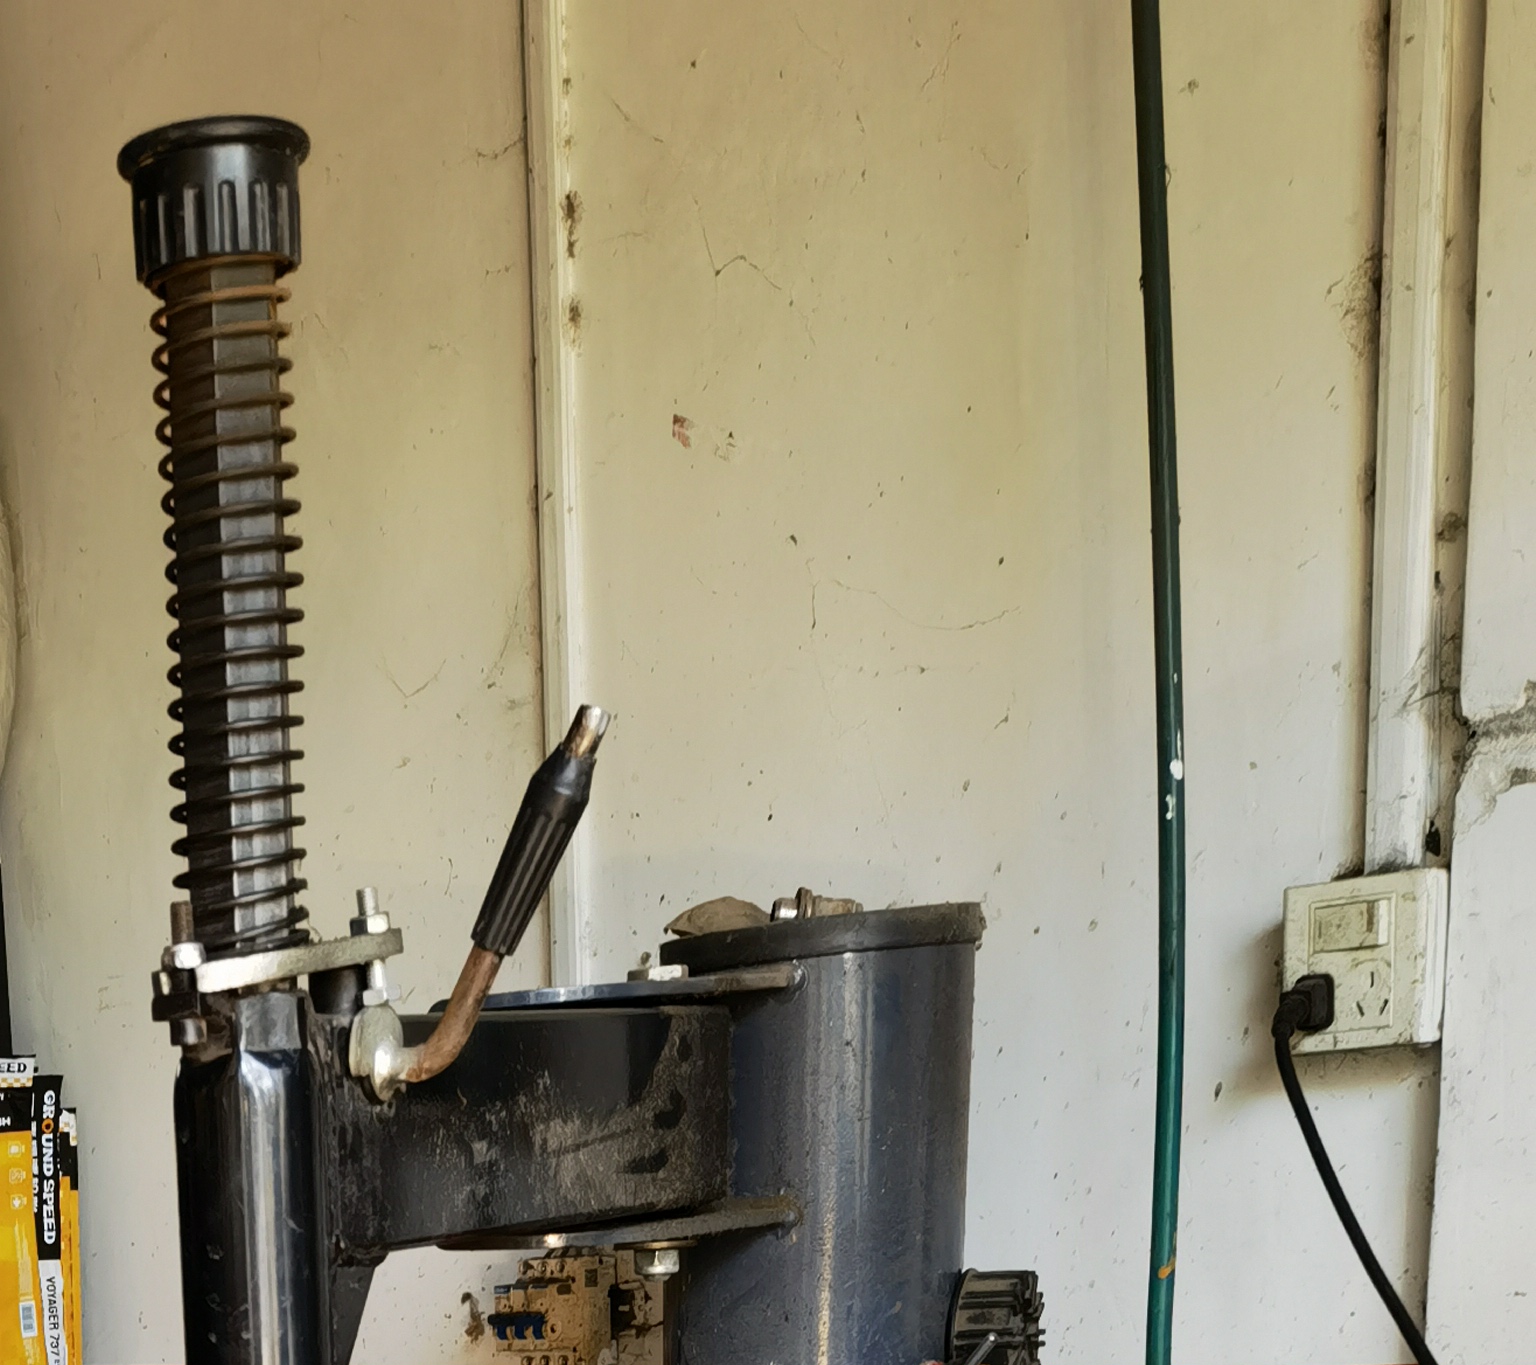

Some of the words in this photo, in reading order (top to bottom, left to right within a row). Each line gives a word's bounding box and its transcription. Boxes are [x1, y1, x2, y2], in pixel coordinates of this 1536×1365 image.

[41, 1089, 56, 1178] GROUND
[43, 1179, 57, 1245] SPEED
[46, 1276, 61, 1337] VOYAGER
